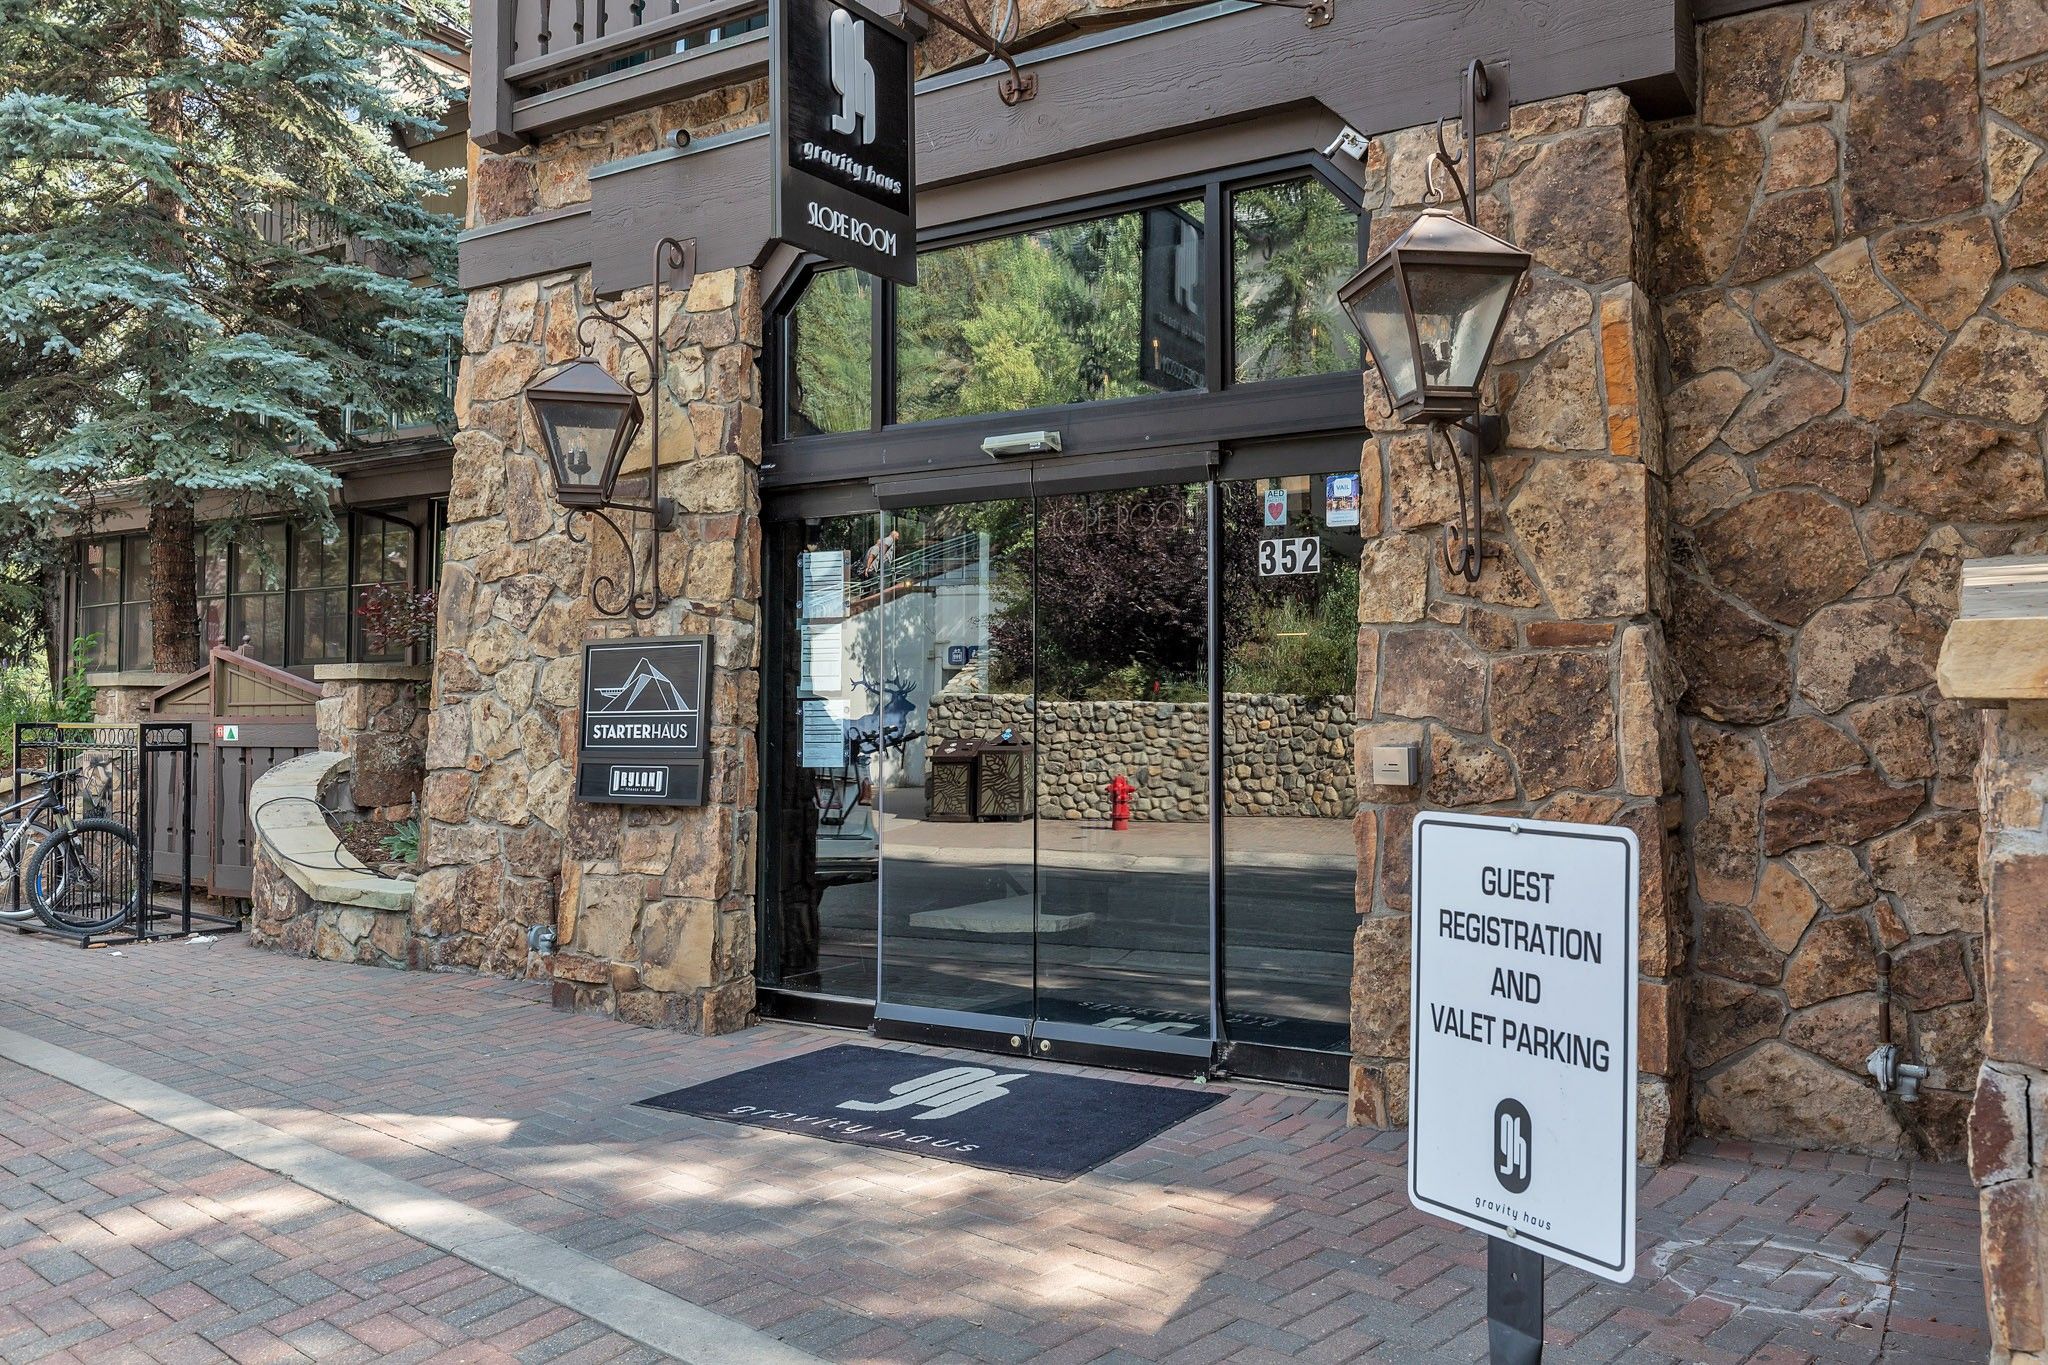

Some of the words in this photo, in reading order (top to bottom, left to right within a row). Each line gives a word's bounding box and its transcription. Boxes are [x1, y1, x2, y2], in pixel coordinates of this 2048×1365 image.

[803, 141, 861, 182] gravity
[866, 165, 902, 195] haus
[807, 201, 849, 240] SLOPE
[851, 218, 897, 257] ROOM
[1267, 489, 1285, 498] AED
[1260, 538, 1319, 575] 352
[1481, 865, 1555, 904] GUEST
[1439, 908, 1602, 964] REGISTRATION
[1490, 967, 1541, 1005] AND
[1430, 1002, 1496, 1045] VALET
[1502, 1019, 1610, 1073] PARKING
[728, 1105, 873, 1134] gravity
[878, 1129, 980, 1152] haus
[1475, 1197, 1518, 1221] gravity
[1523, 1211, 1552, 1231] haus
